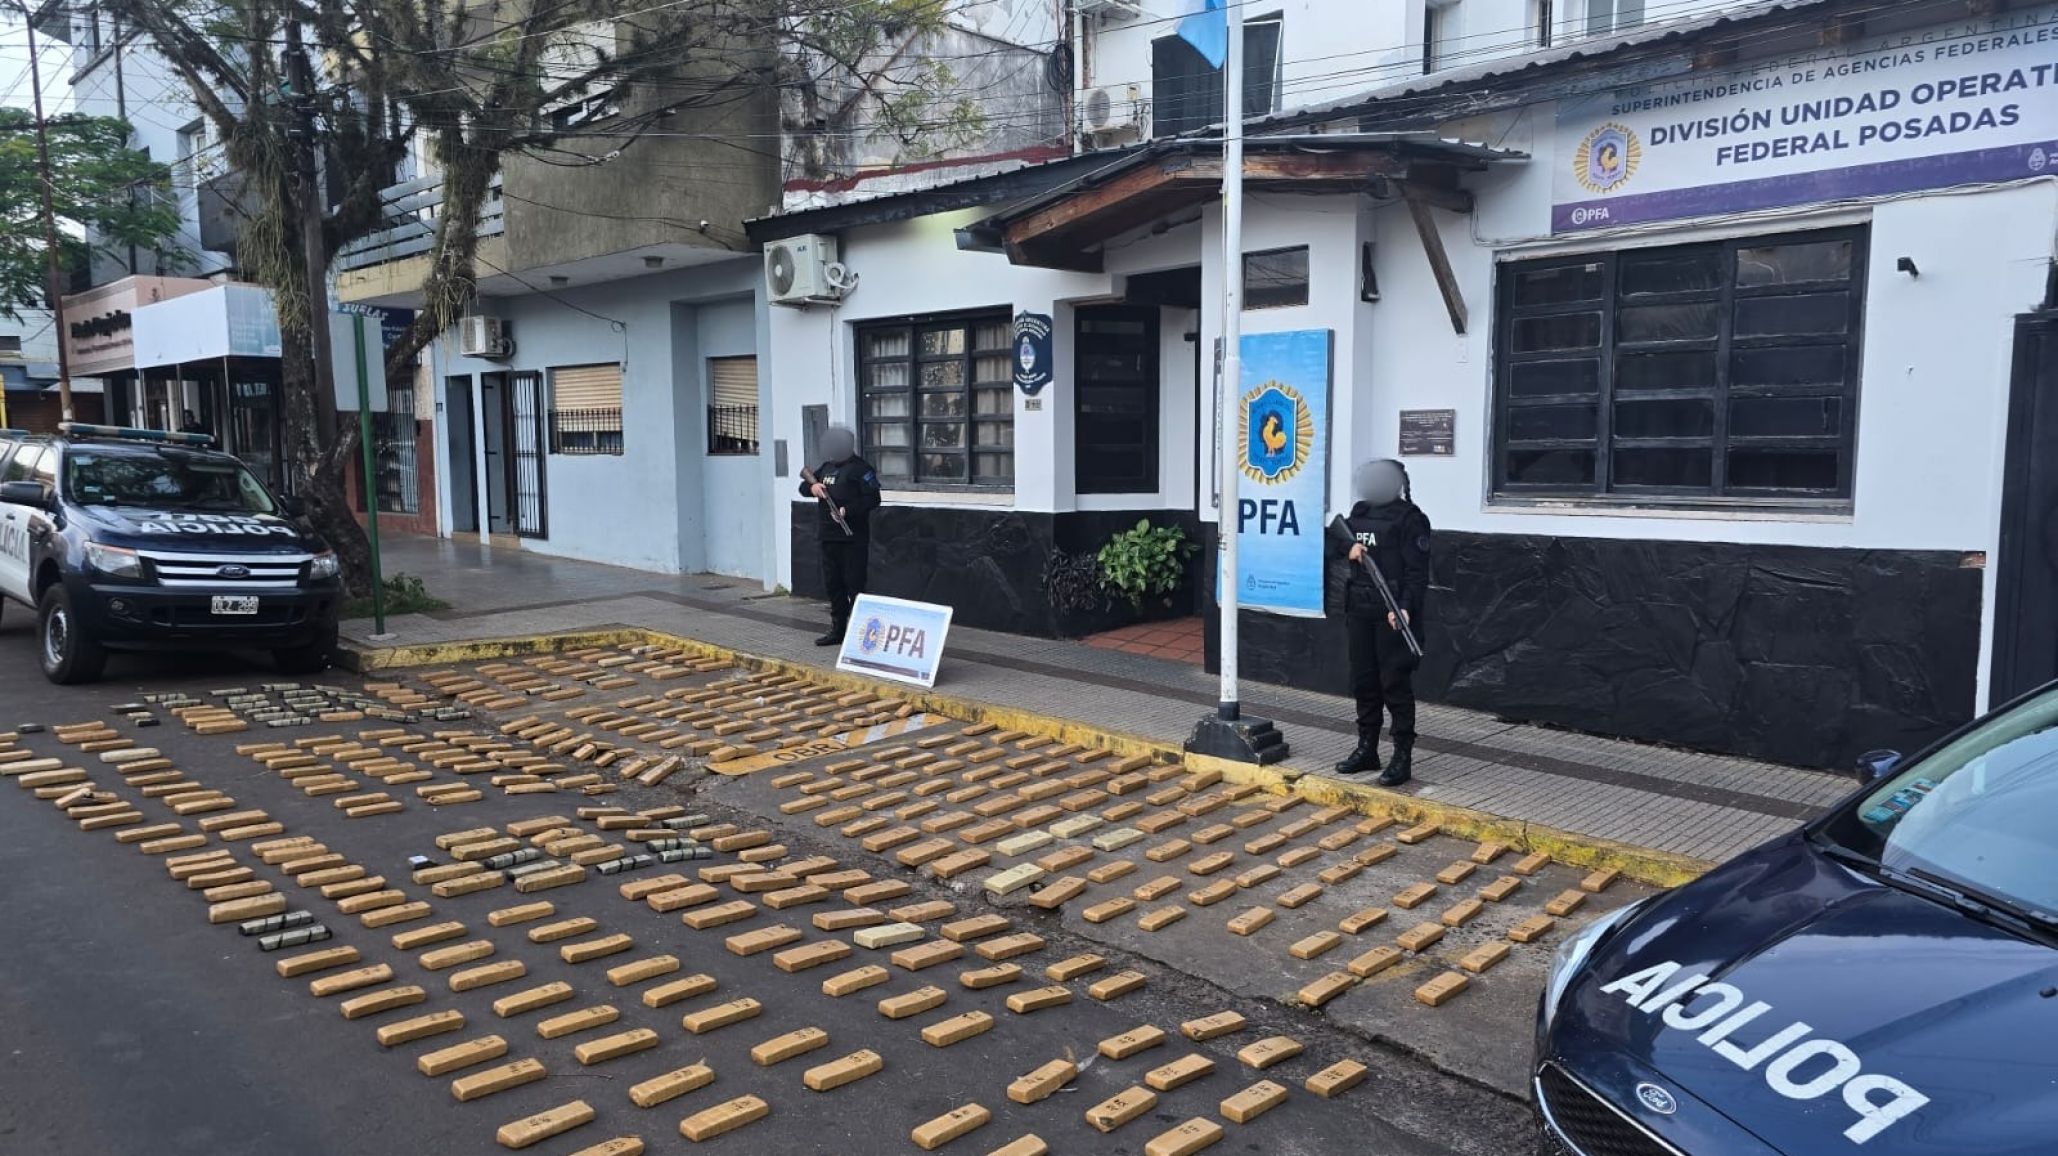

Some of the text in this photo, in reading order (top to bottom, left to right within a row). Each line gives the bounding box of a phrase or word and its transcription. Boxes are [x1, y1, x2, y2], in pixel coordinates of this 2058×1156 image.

[1611, 27, 2058, 115] SUPERINTENDENCIA DE AGENCIAS FEDERALES
[1650, 108, 1772, 146] DIVISIÓN
[1781, 90, 1901, 126] UNIDAD
[1716, 103, 2020, 167] FEDERAL POSADAS
[1587, 206, 1610, 221] PFA
[1237, 498, 1300, 536] PFA
[1356, 532, 1376, 546] PFA
[883, 624, 925, 659] PFA
